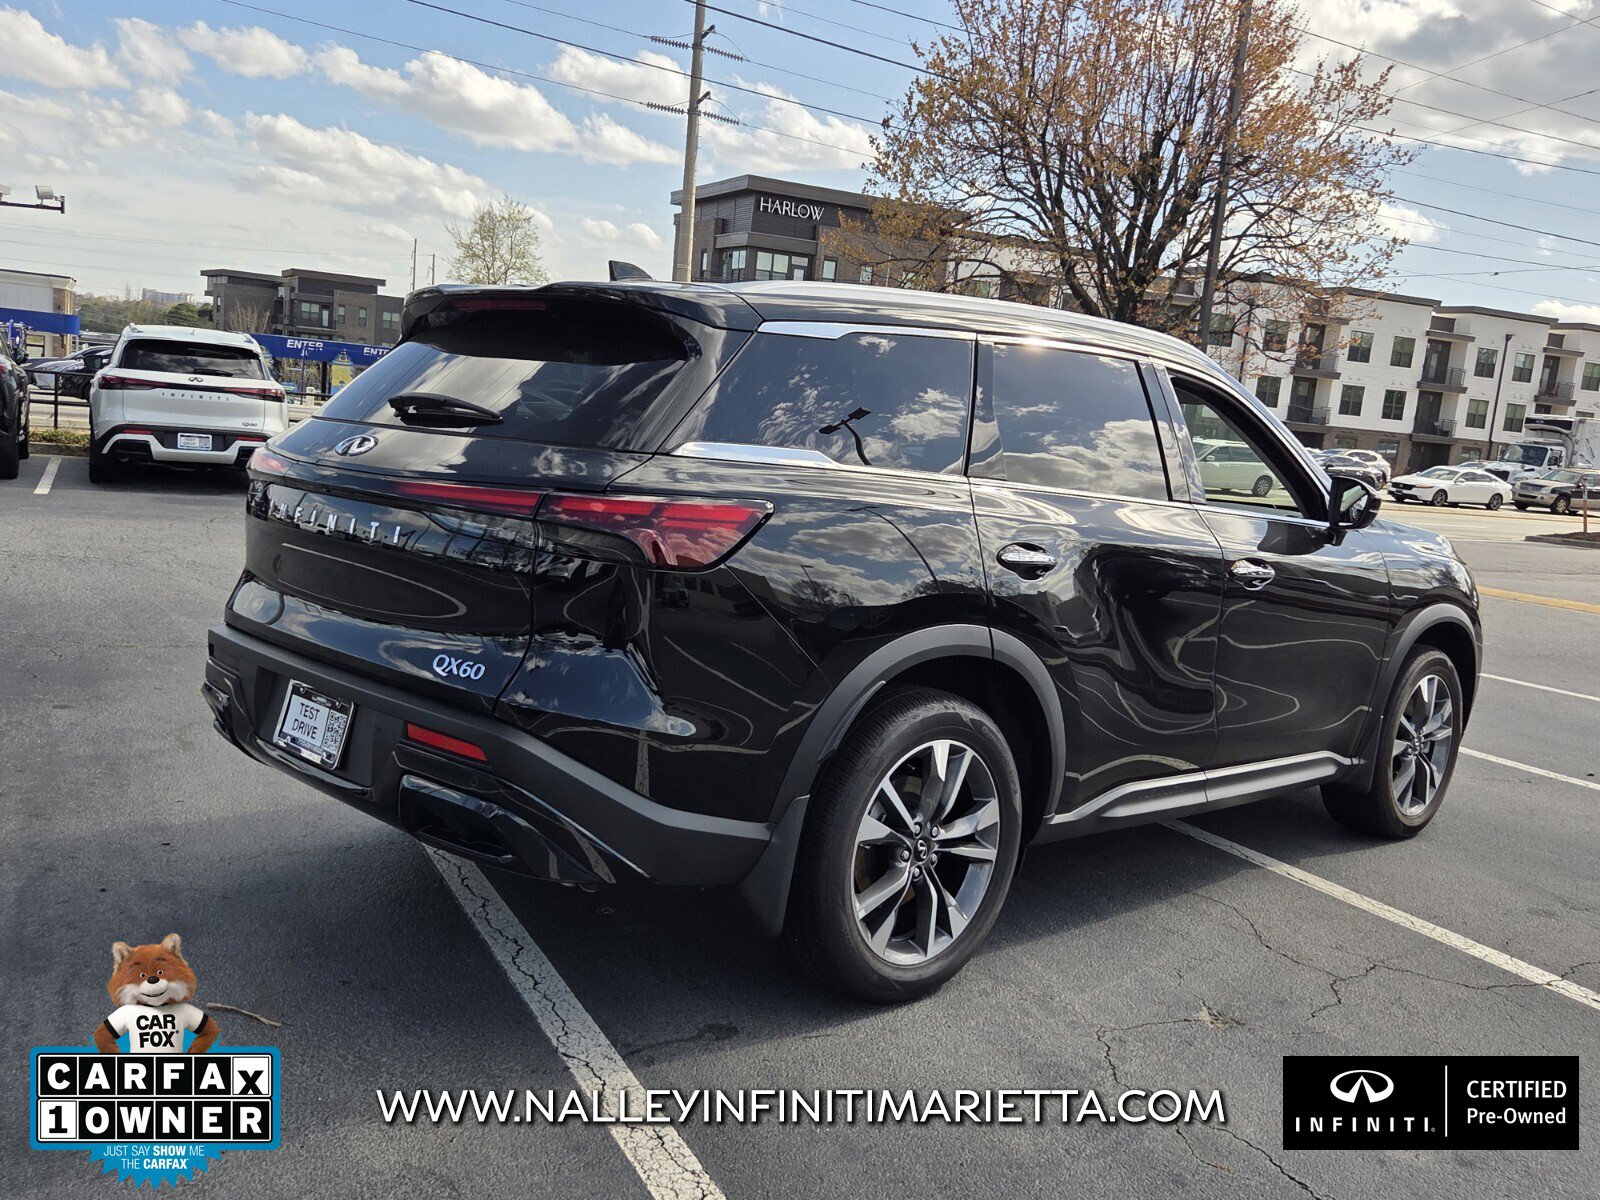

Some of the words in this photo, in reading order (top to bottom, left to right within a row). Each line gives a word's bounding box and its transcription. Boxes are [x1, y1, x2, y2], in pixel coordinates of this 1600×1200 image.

[760, 197, 825, 221] HARLOW
[286, 339, 323, 351] ENTER
[162, 392, 229, 401] INFINITI
[432, 654, 486, 681] QX60
[299, 702, 320, 722] TEST
[291, 718, 318, 740] DRIVE
